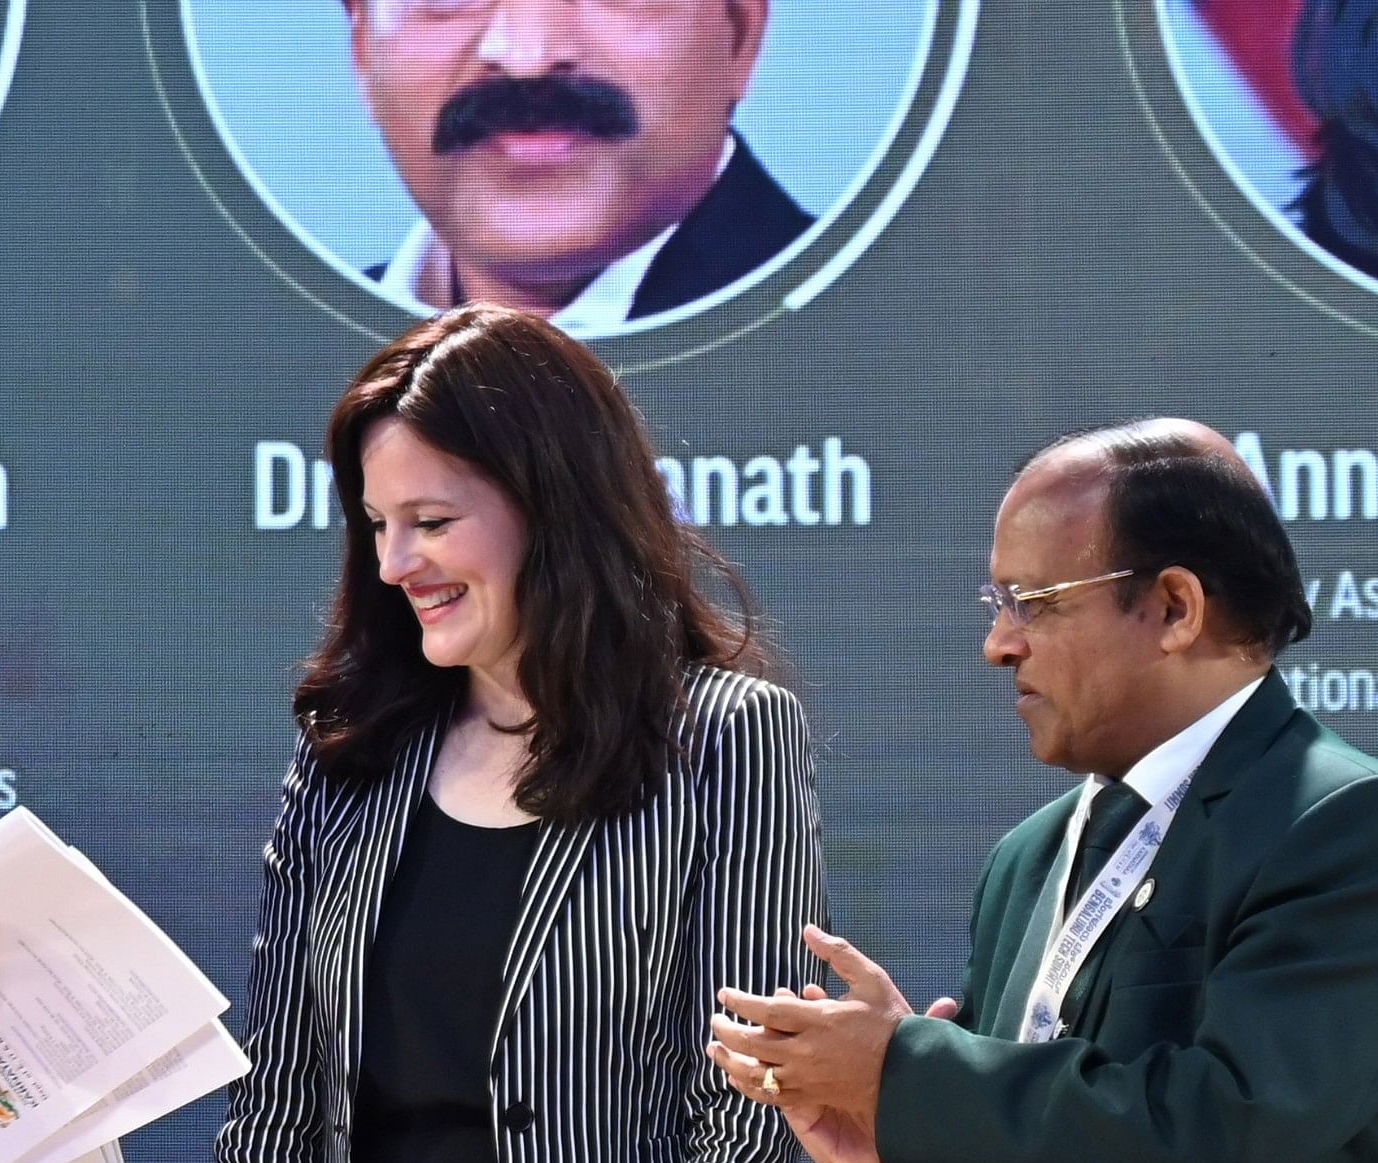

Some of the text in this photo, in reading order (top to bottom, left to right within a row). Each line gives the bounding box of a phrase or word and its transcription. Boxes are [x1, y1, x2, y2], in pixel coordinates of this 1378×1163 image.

[1044, 889, 1106, 989] BENGALURU TECH SUMMIT
